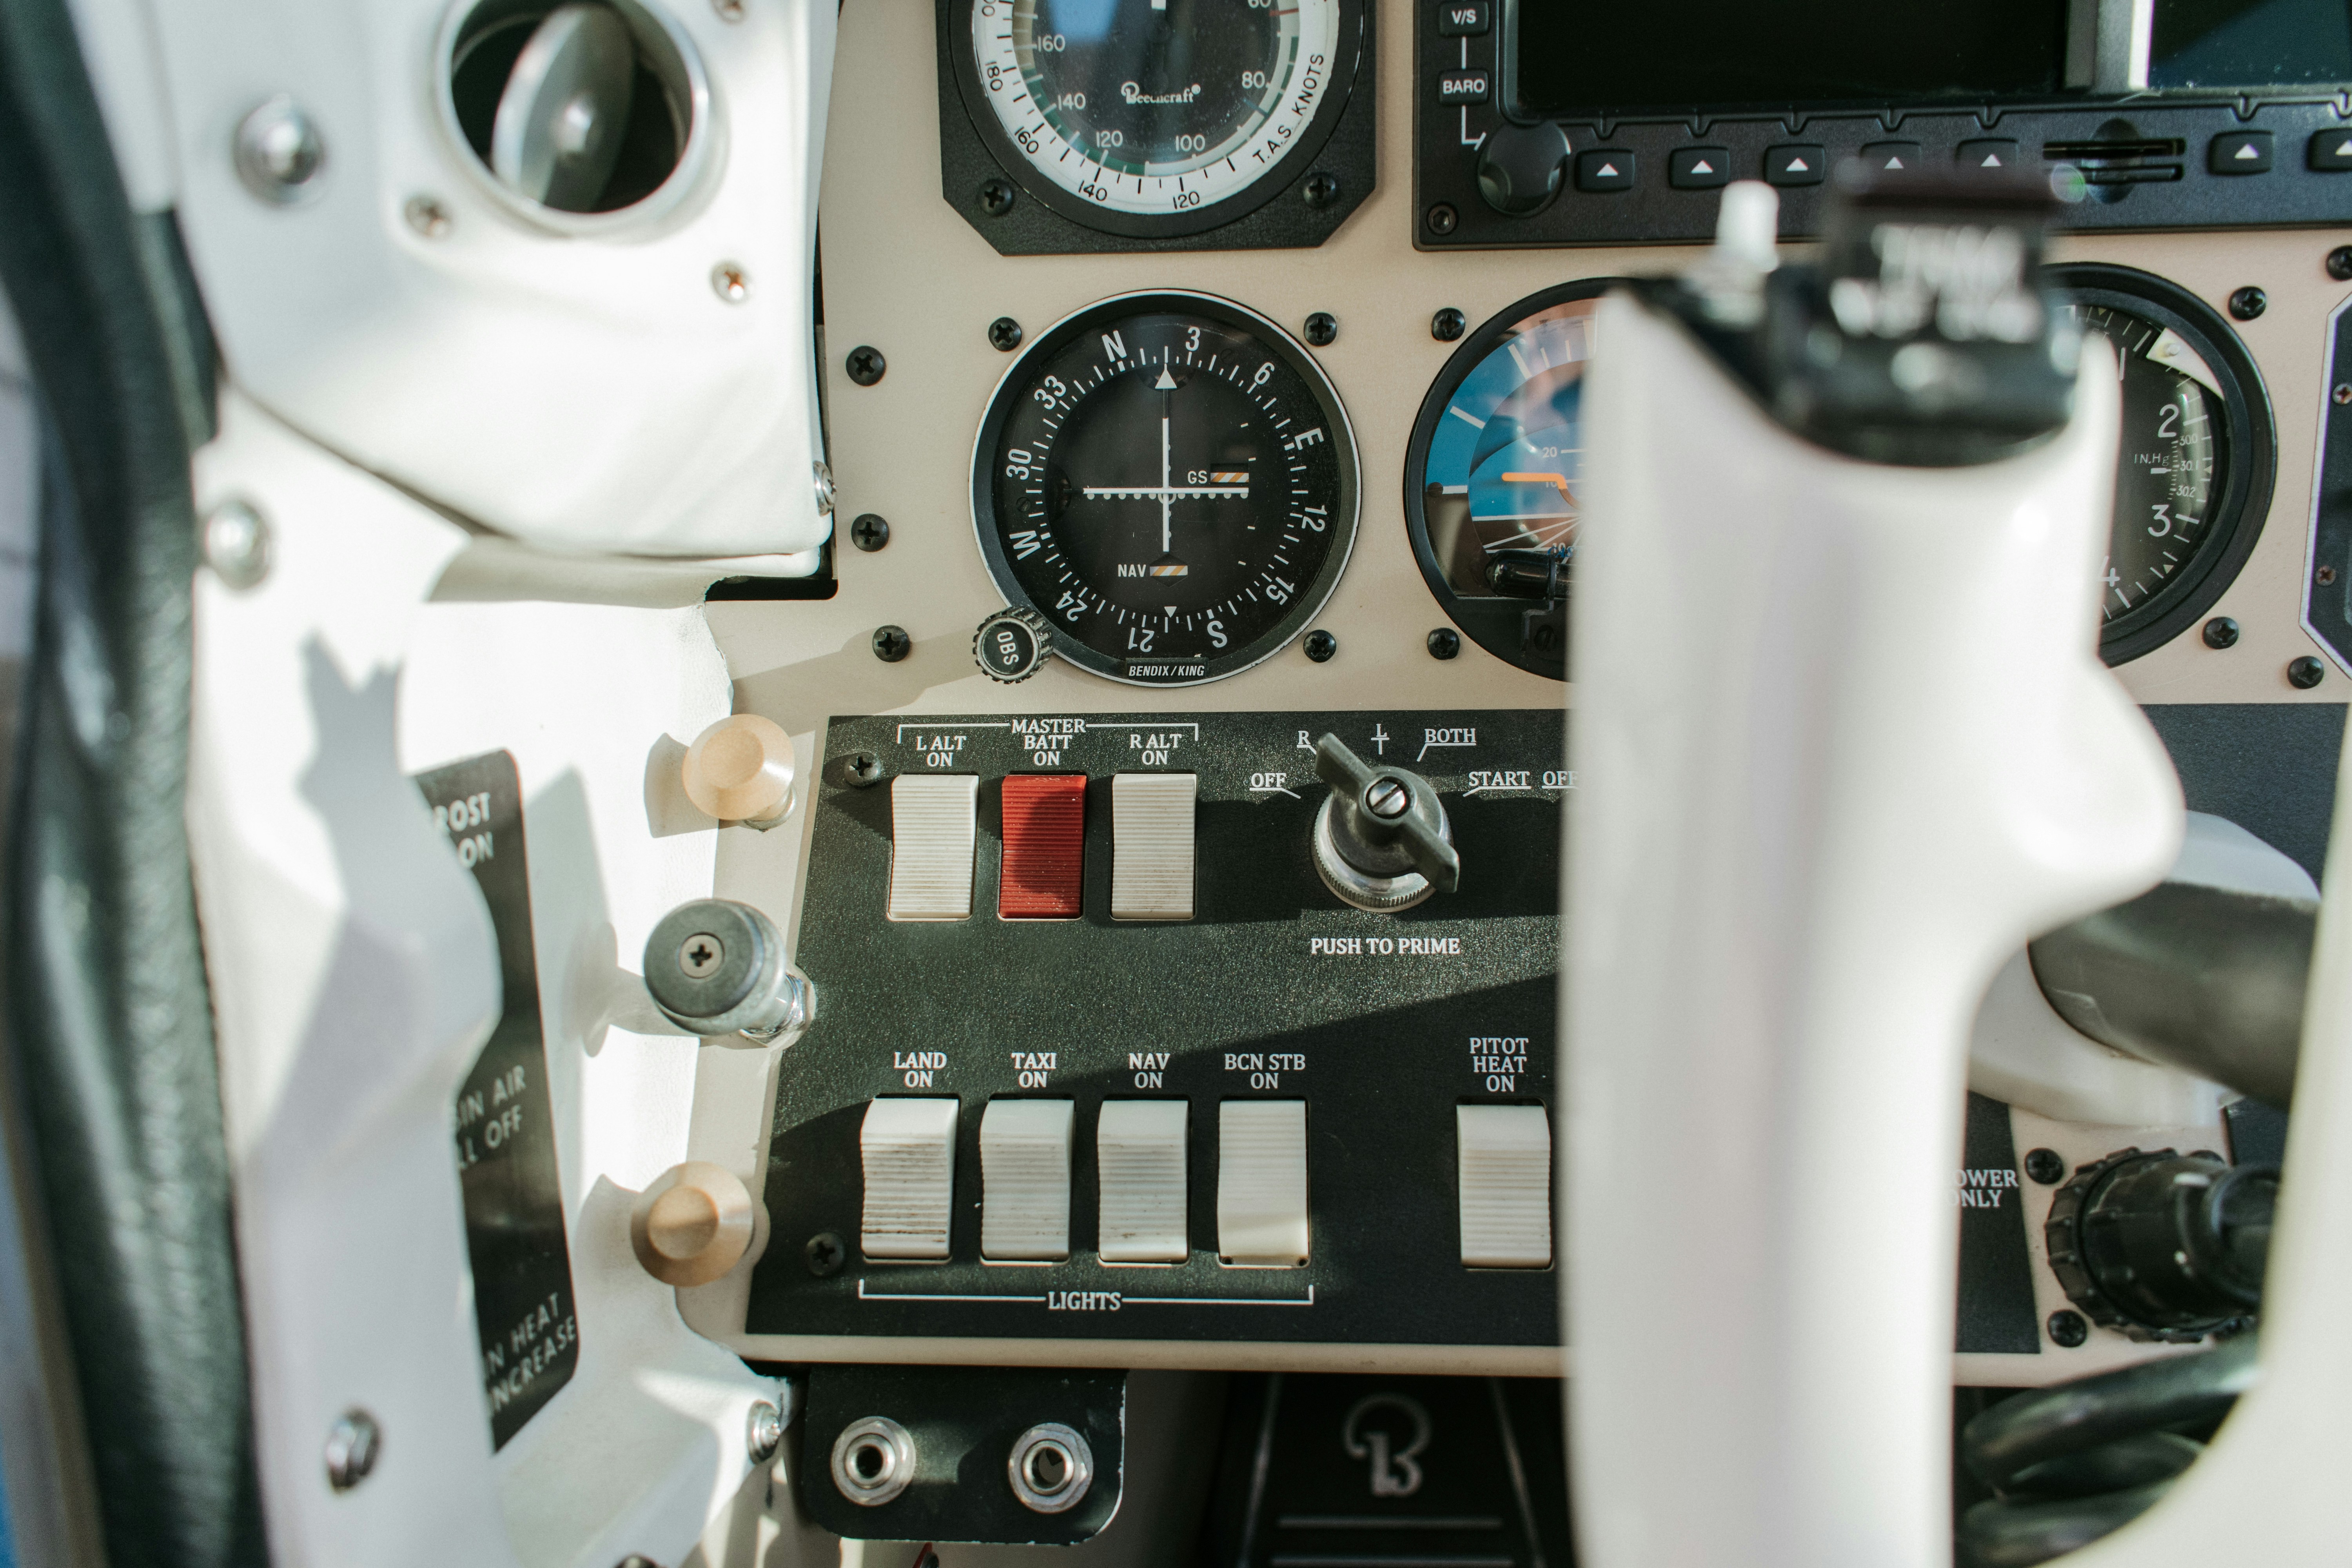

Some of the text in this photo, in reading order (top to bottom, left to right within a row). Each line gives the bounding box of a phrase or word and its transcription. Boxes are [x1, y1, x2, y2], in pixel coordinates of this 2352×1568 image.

[1452, 9, 1477, 25] V/S
[1038, 34, 1065, 52] 160
[985, 61, 1003, 91] 180
[1242, 71, 1265, 89] 80
[1292, 53, 1324, 116] KNOTS
[1443, 78, 1485, 94] BARO
[1058, 93, 1085, 110] 140
[1015, 126, 1038, 154] 160
[1096, 131, 1123, 147] 120
[1175, 134, 1205, 151] 100
[1078, 181, 1107, 202] 140
[1173, 191, 1200, 209] 120
[1102, 330, 1127, 362] N
[1186, 327, 1200, 351] 3
[1255, 362, 1274, 385] 6
[1034, 376, 1067, 410] 33
[2158, 404, 2179, 437] 2
[1294, 428, 1324, 450] E
[2180, 434, 2198, 446] 30.0
[1543, 447, 1557, 458] 20
[1006, 448, 1032, 480] 30
[2180, 460, 2199, 471] 30.1
[1188, 470, 1207, 484] GS
[2176, 485, 2196, 498] 30.2
[1301, 505, 1327, 532] 12
[2148, 505, 2170, 537] 3
[1009, 530, 1041, 560] W
[1118, 564, 1146, 577] NAV
[2096, 555, 2120, 587] 4
[1265, 576, 1294, 605] 15
[1056, 590, 1088, 621] 24
[1128, 628, 1153, 652] 21
[1207, 621, 1227, 648] S
[997, 632, 1019, 665] OBS
[1012, 719, 1085, 733] MASTER
[916, 736, 966, 750] L ALT
[1024, 735, 1073, 749] BATT
[1130, 734, 1182, 748] R ALT
[1298, 731, 1310, 744] R
[1425, 728, 1476, 743] BOTH
[927, 752, 953, 767] ON
[1034, 751, 1060, 766] ON
[1142, 750, 1168, 765] ON
[1251, 773, 1287, 787] OFF
[1469, 771, 1530, 786] START
[1311, 938, 1460, 954] PUSH TO PRIME
[1470, 1038, 1528, 1054] PITOT
[894, 1052, 947, 1069] LAND
[1011, 1053, 1056, 1069] TAXI
[1129, 1053, 1170, 1069] NAV
[1225, 1054, 1305, 1070] BCN STB
[1474, 1056, 1527, 1073] HEAT
[493, 1065, 526, 1106] AIR
[905, 1071, 933, 1087] ON
[1019, 1071, 1047, 1087] ON
[1135, 1072, 1162, 1088] ON
[1251, 1073, 1278, 1089] ON
[1486, 1075, 1514, 1092] ON
[485, 1104, 523, 1149] OFF
[1049, 1292, 1120, 1310] LIGHTS
[510, 1292, 558, 1355] HEAT
[490, 1315, 576, 1414] NCREASE
